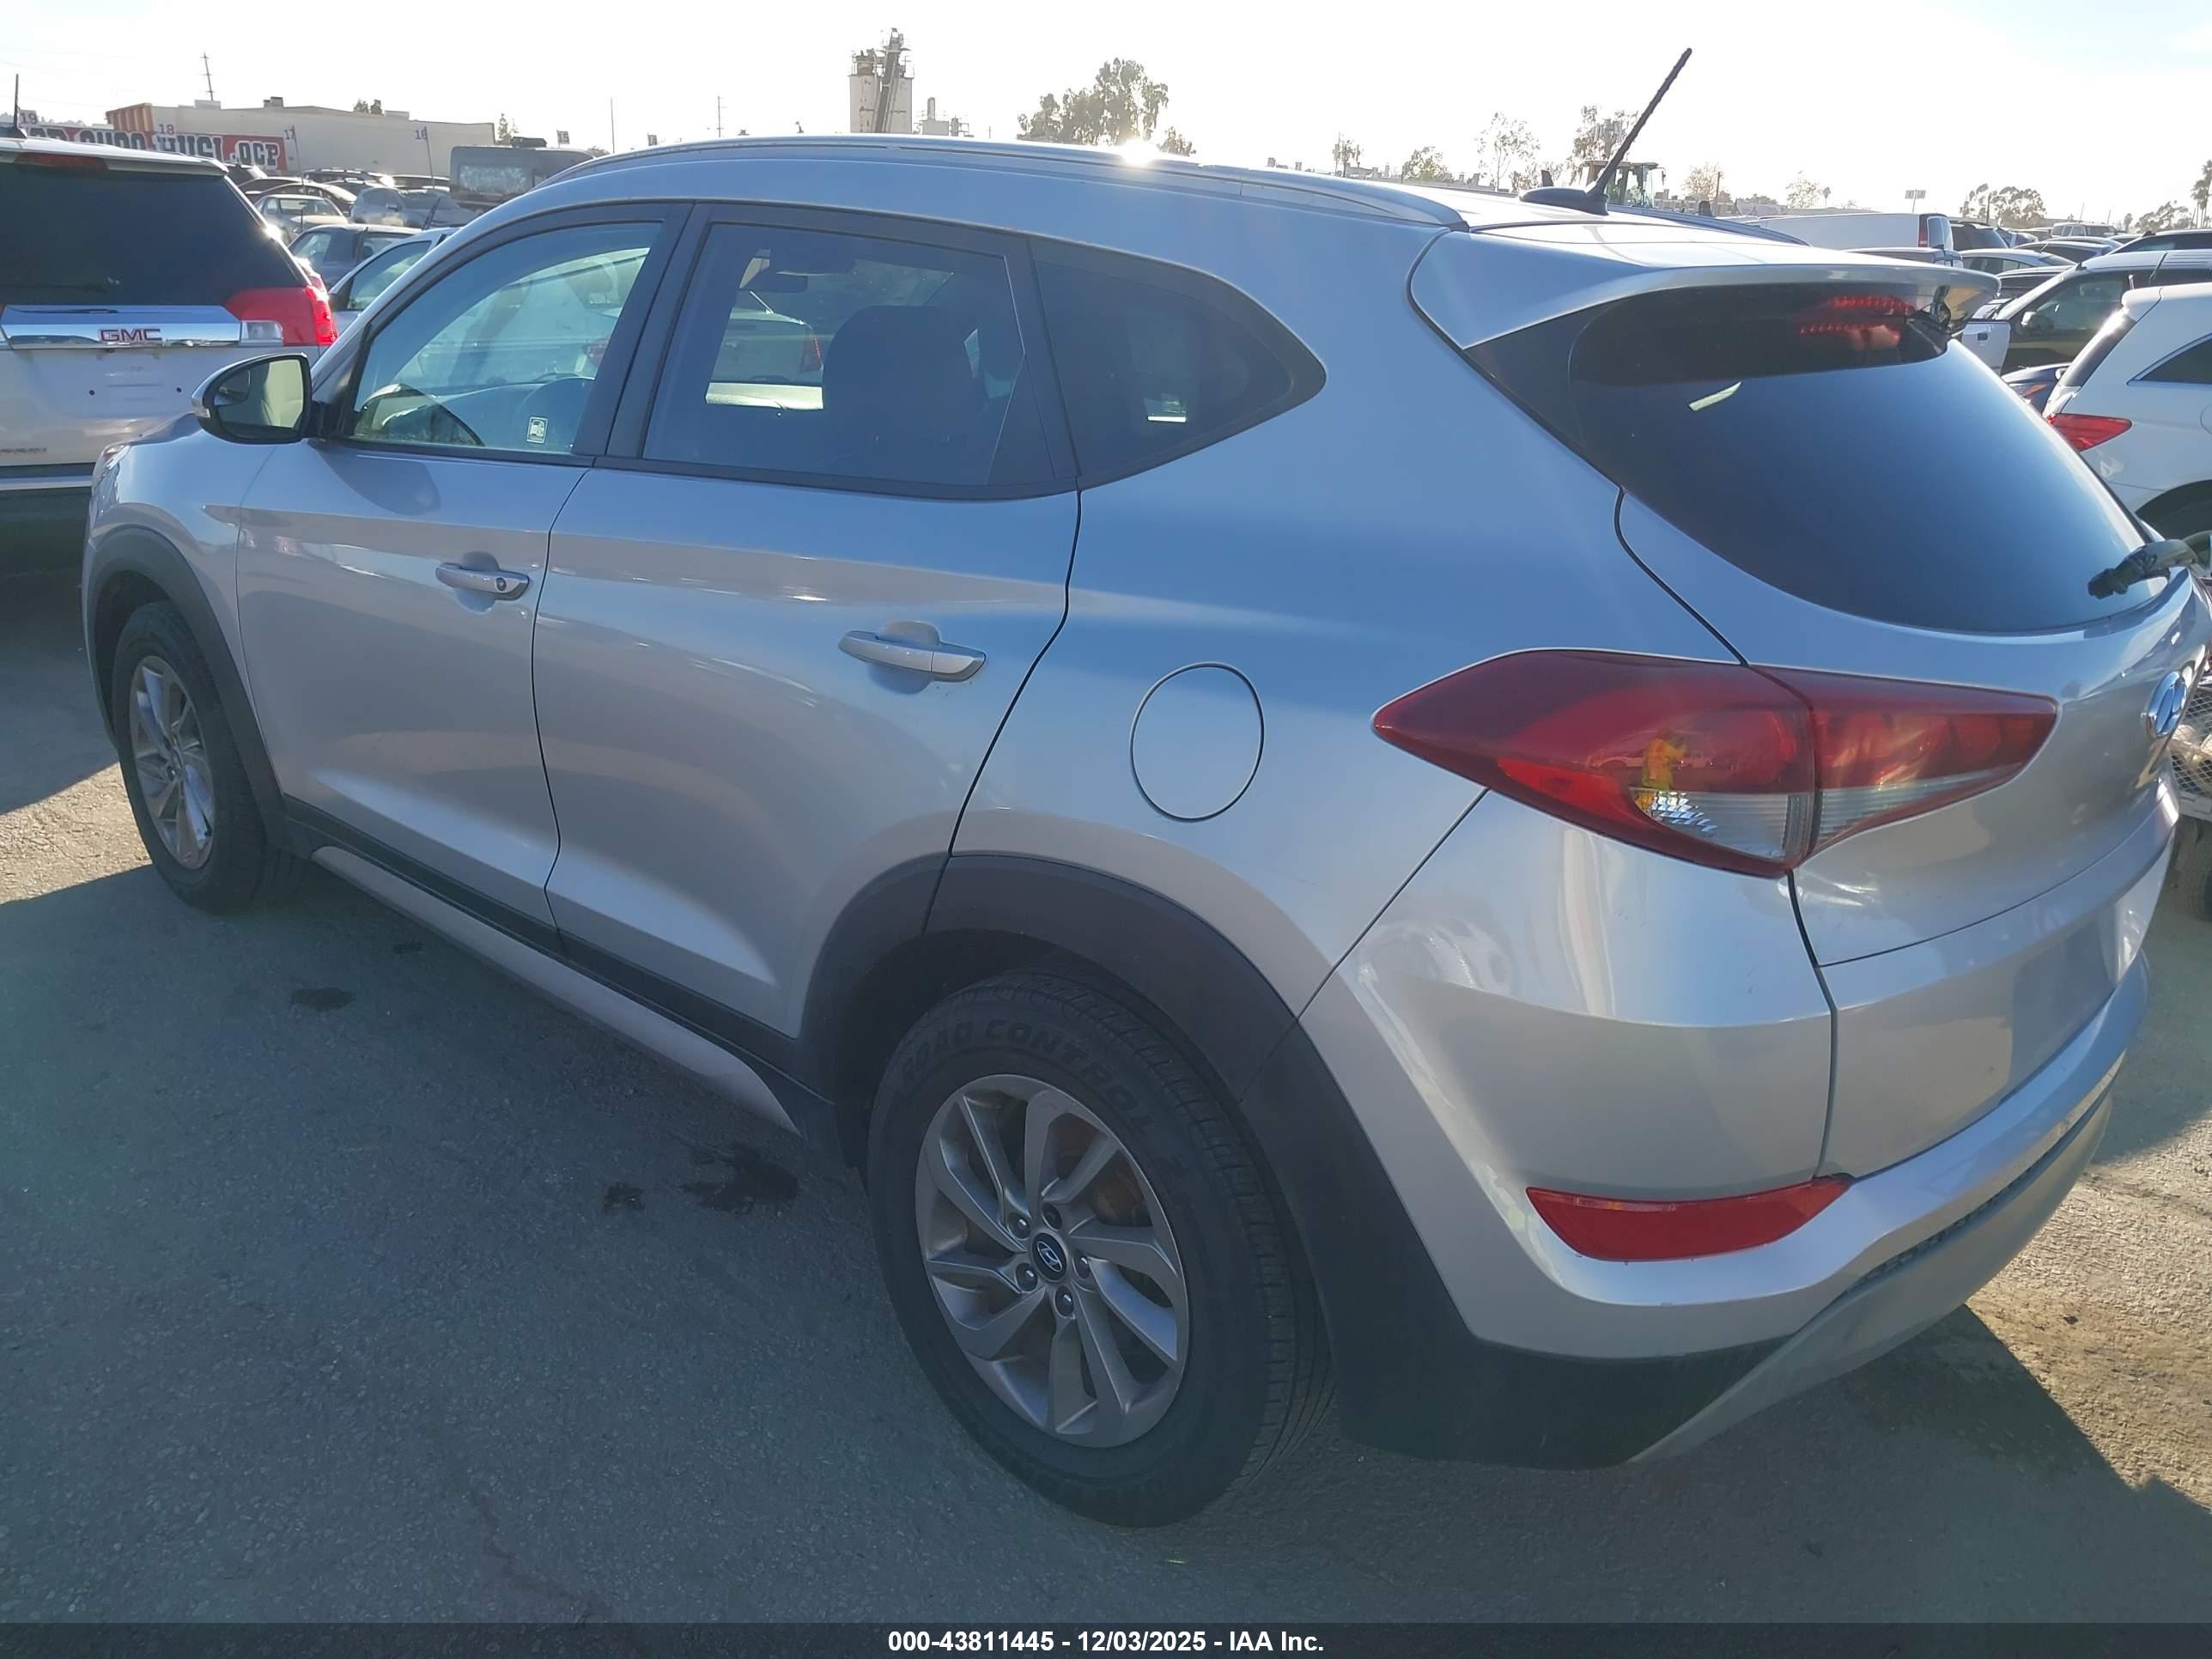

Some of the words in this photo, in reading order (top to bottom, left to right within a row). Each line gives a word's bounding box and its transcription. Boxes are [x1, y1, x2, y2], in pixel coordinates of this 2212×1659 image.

[20, 112, 38, 125] 19
[158, 124, 175, 136] 18
[100, 328, 163, 342] GMC
[985, 1018, 1157, 1135] CONTROL
